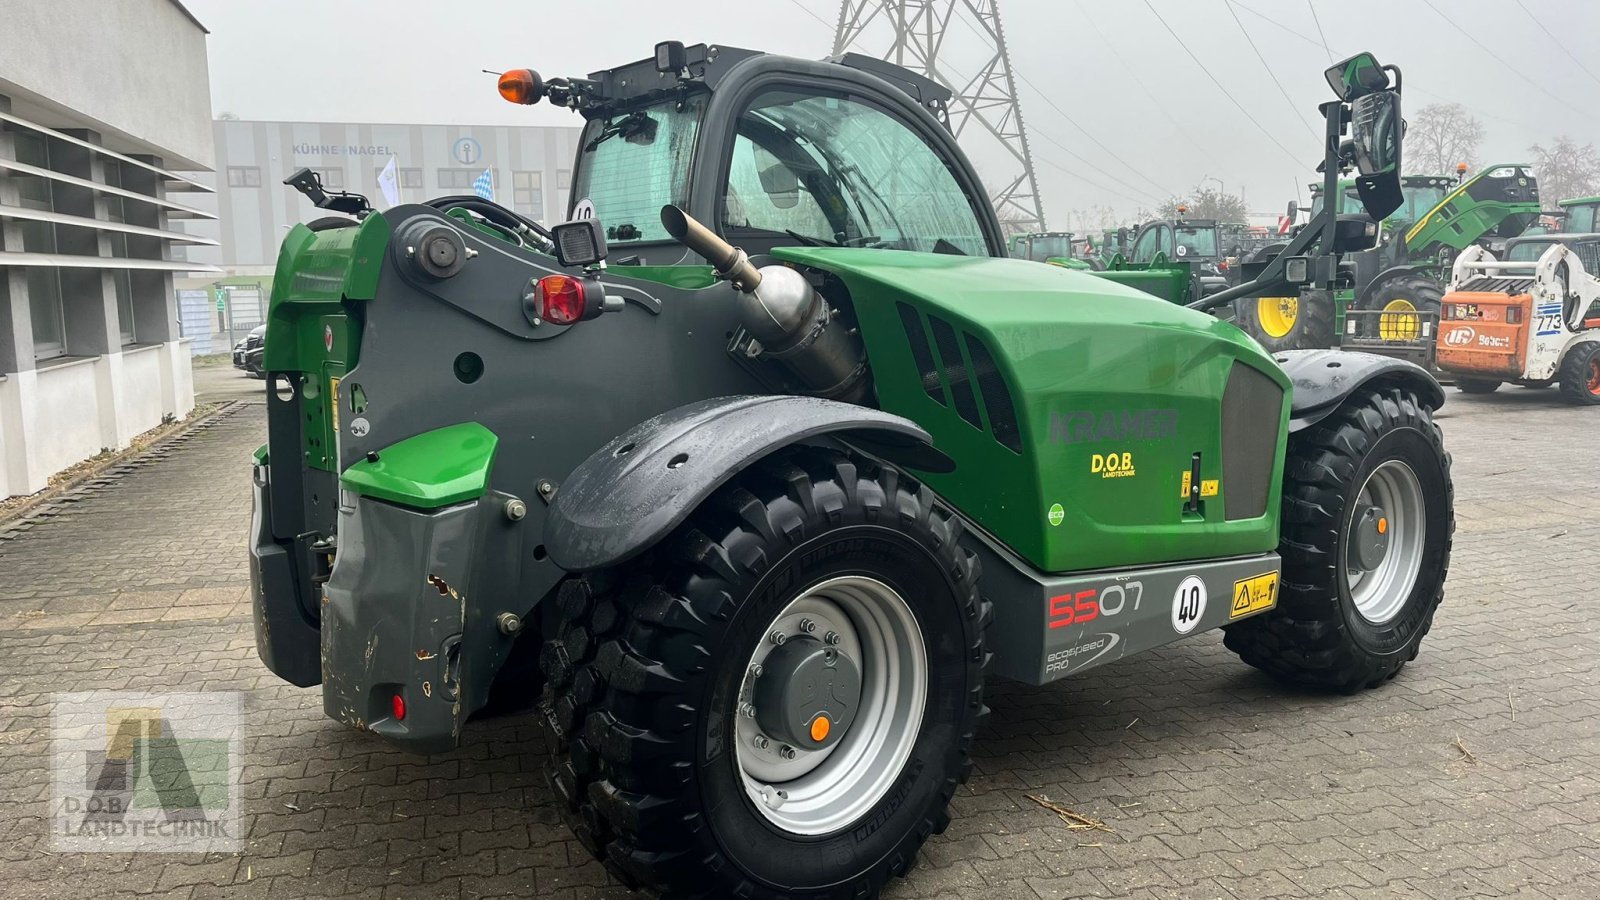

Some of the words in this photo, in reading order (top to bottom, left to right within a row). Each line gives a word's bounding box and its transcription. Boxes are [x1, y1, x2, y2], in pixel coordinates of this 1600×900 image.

[1537, 314, 1562, 331] 773
[1050, 409, 1178, 444] KRAMER
[1091, 452, 1134, 473] D.O.B.
[1049, 581, 1144, 629] 5507
[1178, 586, 1199, 624] 40
[1047, 637, 1105, 663] ecospeed
[1046, 659, 1069, 674] PRO
